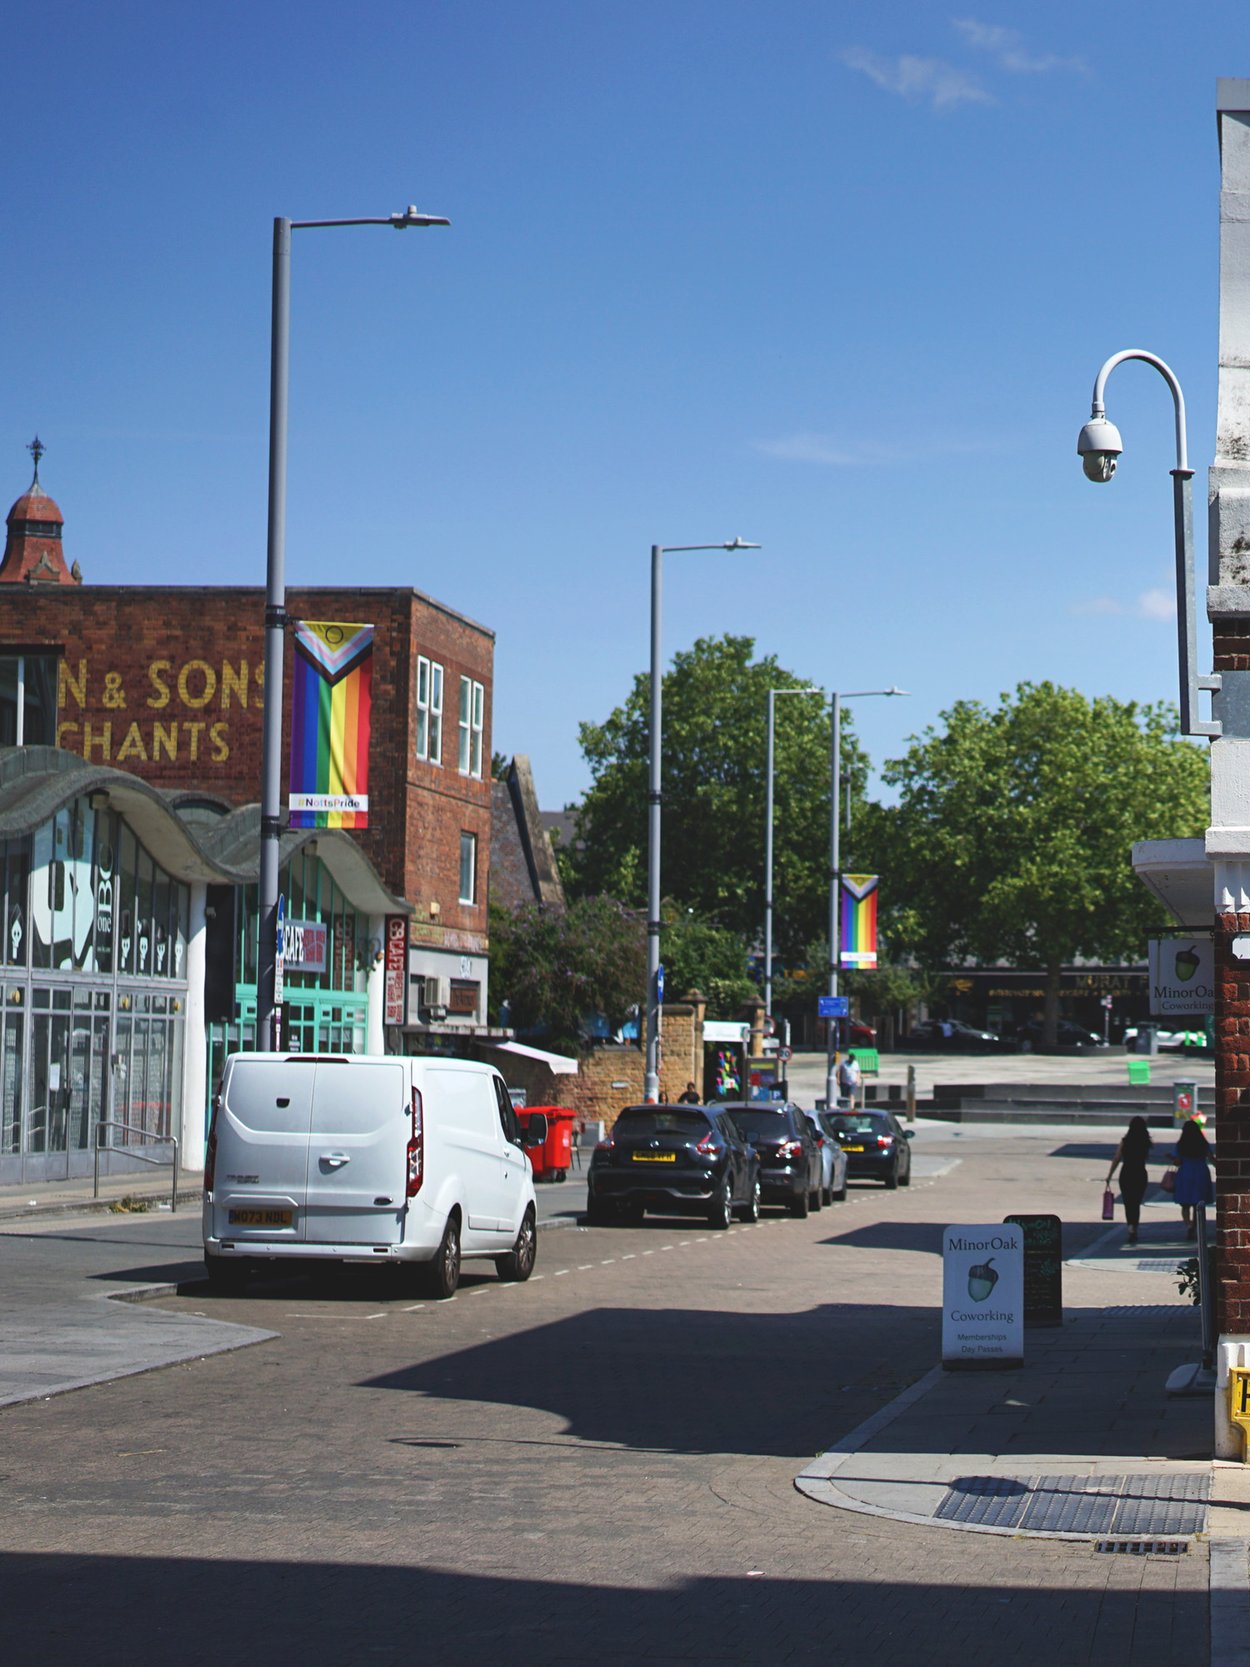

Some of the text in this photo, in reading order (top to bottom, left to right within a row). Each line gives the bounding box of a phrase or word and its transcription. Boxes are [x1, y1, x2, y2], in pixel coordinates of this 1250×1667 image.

[102, 671, 127, 709] &
[298, 798, 361, 807] #NottsPride
[1154, 985, 1214, 999] MinorOa
[948, 1237, 1018, 1251] MinorOak
[950, 1310, 1014, 1324] Coworking
[957, 1333, 1007, 1342] Memberships
[961, 1345, 975, 1354] Day
